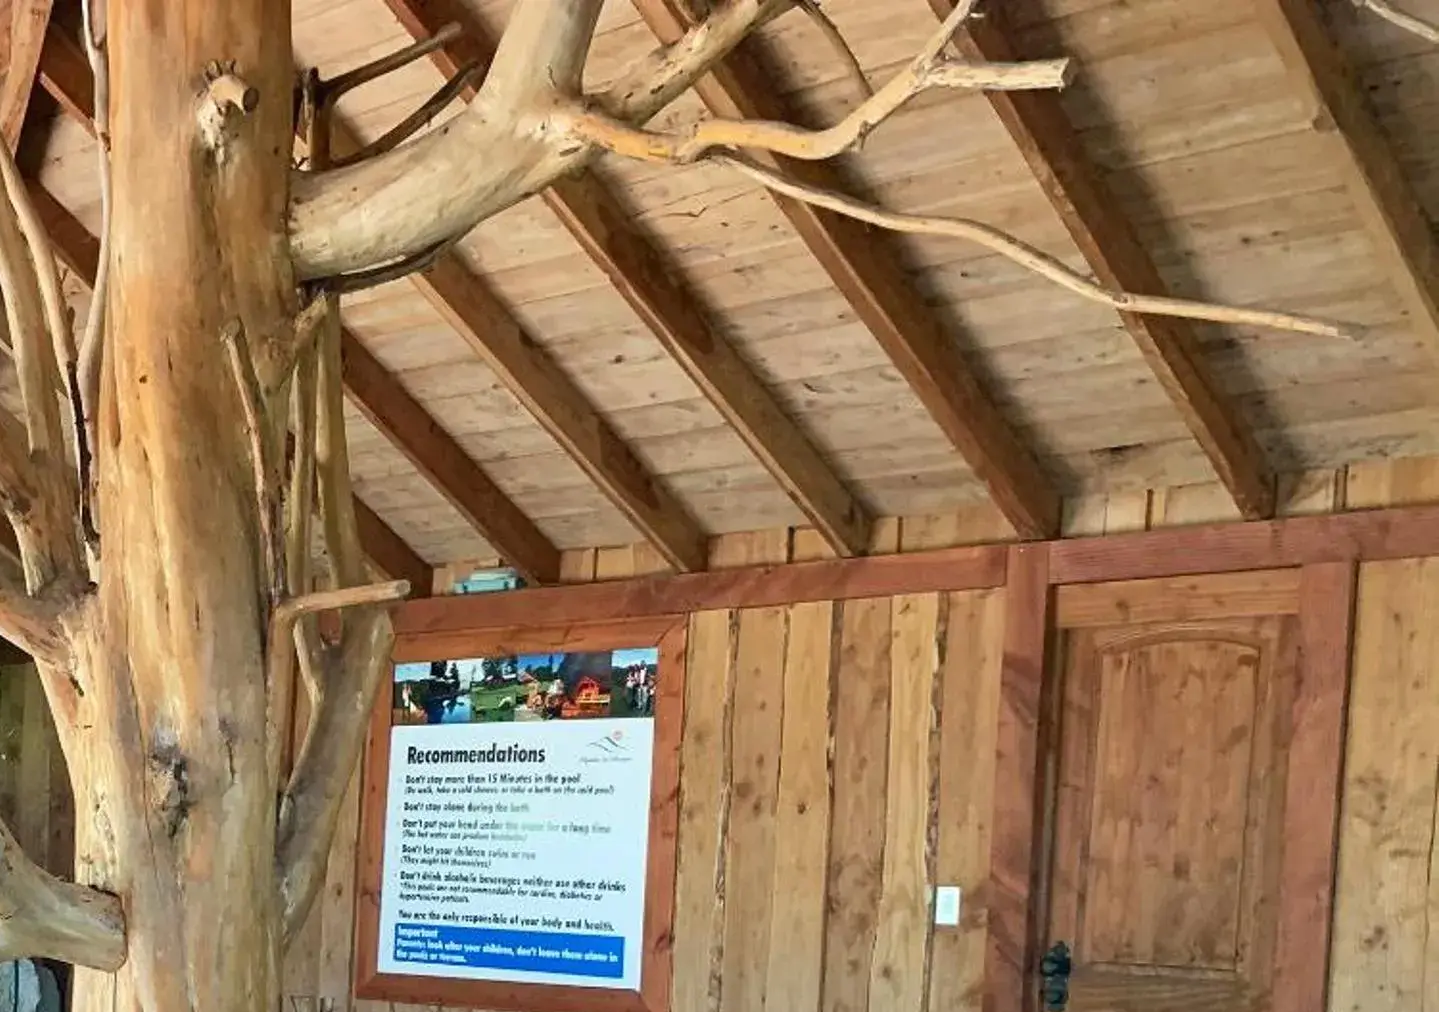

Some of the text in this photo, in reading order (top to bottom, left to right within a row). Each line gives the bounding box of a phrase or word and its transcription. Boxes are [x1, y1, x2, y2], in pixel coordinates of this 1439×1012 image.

[407, 742, 545, 764] Recommendations
[406, 774, 425, 784] Don't
[427, 776, 443, 786] stay
[467, 773, 486, 784] than
[488, 773, 498, 784] 15
[534, 773, 543, 784] in
[545, 773, 559, 784] the
[561, 772, 581, 785] pool
[403, 801, 424, 811] Don't
[425, 803, 441, 814] stay
[443, 801, 465, 812] alone
[467, 801, 493, 814] during
[402, 819, 422, 829] Don't
[402, 844, 422, 853] Don't
[454, 845, 486, 857] children
[400, 871, 421, 880] Don't
[422, 871, 441, 881] drink
[523, 875, 553, 888] neither
[572, 879, 596, 889] other
[597, 880, 626, 892] drinks
[398, 909, 412, 919] You
[428, 910, 441, 920] the
[442, 911, 460, 922] only
[461, 912, 507, 924] responsible
[520, 918, 539, 927] your
[541, 916, 562, 930] body
[565, 919, 582, 930] and
